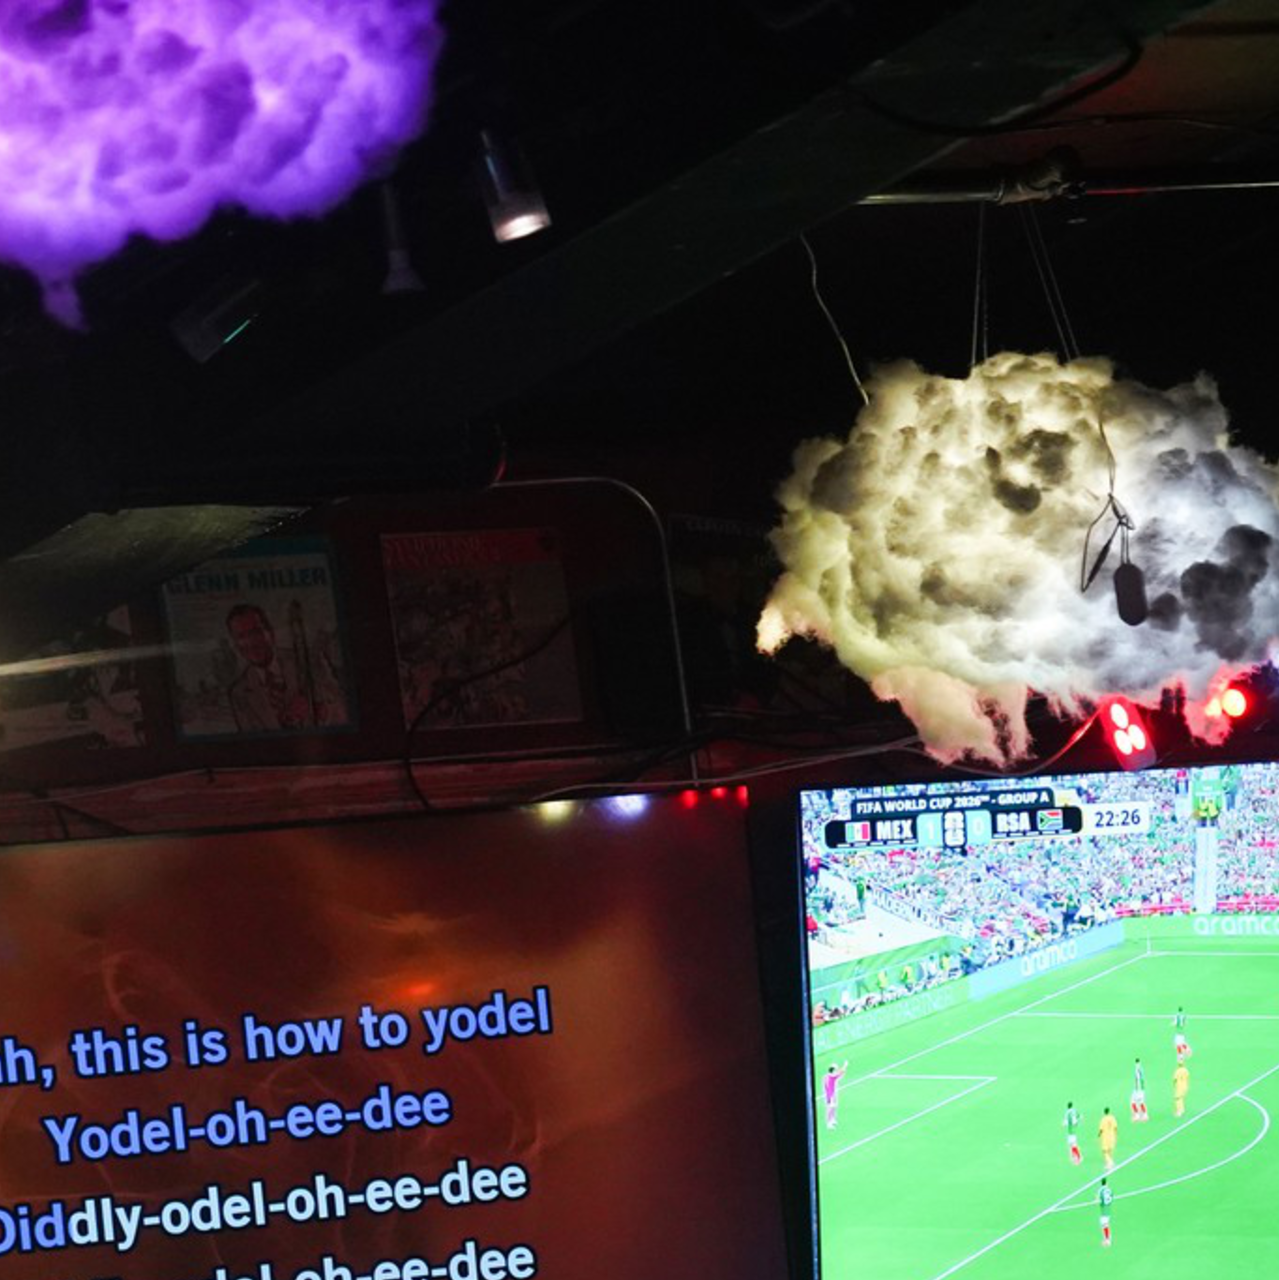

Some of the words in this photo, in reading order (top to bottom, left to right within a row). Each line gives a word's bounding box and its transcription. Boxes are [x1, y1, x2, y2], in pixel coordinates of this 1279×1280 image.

[247, 567, 327, 591] MILLER
[856, 801, 883, 814] FIFA
[884, 798, 927, 813] WORLD
[929, 797, 953, 810] CUP
[997, 793, 1039, 805] GROUP
[1039, 791, 1050, 803] A
[876, 819, 914, 841] MEX
[996, 812, 1032, 833] RSA
[1094, 809, 1141, 829] 22:26
[71, 1027, 169, 1076] this
[185, 1021, 228, 1065] is
[244, 1016, 343, 1060] how
[358, 1005, 409, 1048] to
[422, 988, 550, 1053] yodel
[43, 1085, 451, 1163] Yodel-oh-ee-dee
